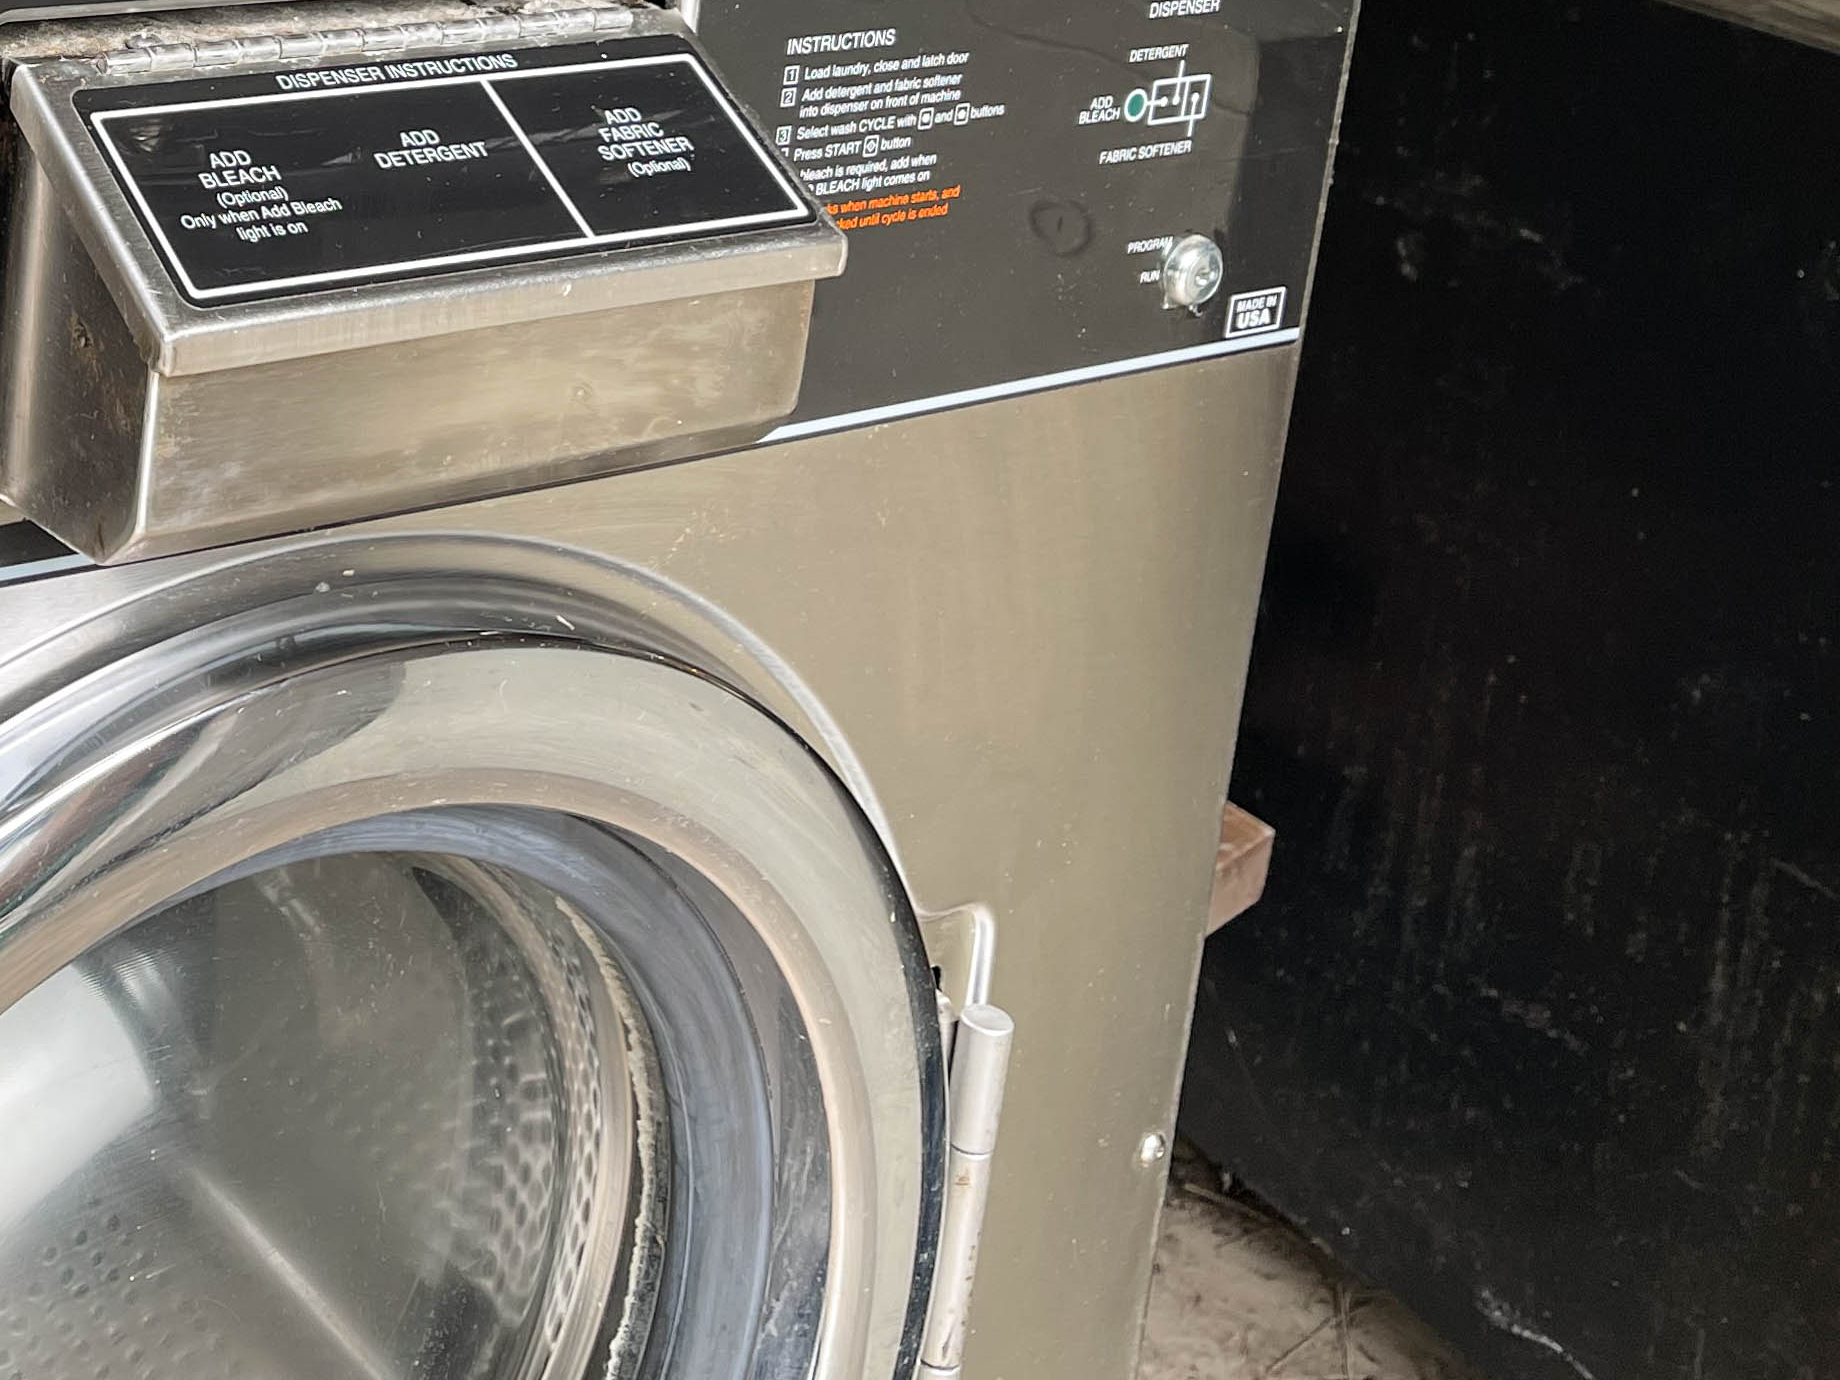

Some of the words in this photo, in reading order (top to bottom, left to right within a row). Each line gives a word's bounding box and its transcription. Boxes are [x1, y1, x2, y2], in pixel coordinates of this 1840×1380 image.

[786, 28, 897, 55] INSTRUCTIONS
[1129, 43, 1190, 63] DETERGENT
[276, 64, 386, 91] DISPENSER
[388, 53, 519, 80] INSTRUCTIONS
[804, 67, 831, 81] Load
[873, 59, 900, 72] close
[901, 56, 921, 70] and
[946, 50, 970, 65] door
[801, 88, 823, 102] Add
[824, 83, 872, 102] detergent
[873, 80, 892, 94] and
[893, 76, 922, 92] fabric
[923, 72, 963, 88] softener
[820, 100, 869, 119] dispenser
[920, 88, 962, 105] machine
[1090, 95, 1114, 111] ADD
[604, 107, 642, 125] ADD
[797, 124, 830, 140] Select
[830, 120, 858, 135] wash
[858, 115, 897, 133] CYCLE
[970, 103, 1006, 118] buttons
[1078, 106, 1121, 125] BLEACH
[399, 128, 440, 148] ADD
[598, 122, 665, 143] FABRIC
[209, 149, 252, 169] ADD
[373, 140, 489, 170] DETERGENT
[597, 136, 695, 161] SOFTENER
[793, 145, 824, 162] Press
[824, 140, 862, 159] START
[880, 135, 912, 151] button
[1098, 146, 1137, 165] FABRIC
[1137, 139, 1193, 160] SOFTENER
[198, 166, 282, 191] BLEACH
[627, 157, 692, 178] (Optional)
[216, 185, 289, 209] (Optional)
[815, 176, 860, 196] BLEACH
[180, 212, 217, 231] Only
[218, 208, 260, 225] when
[261, 204, 291, 220] Add
[292, 197, 343, 216] Bleach
[236, 225, 272, 244] light
[1237, 298, 1265, 313] MADE
[1265, 294, 1278, 308] IN
[1237, 308, 1271, 329] USA
